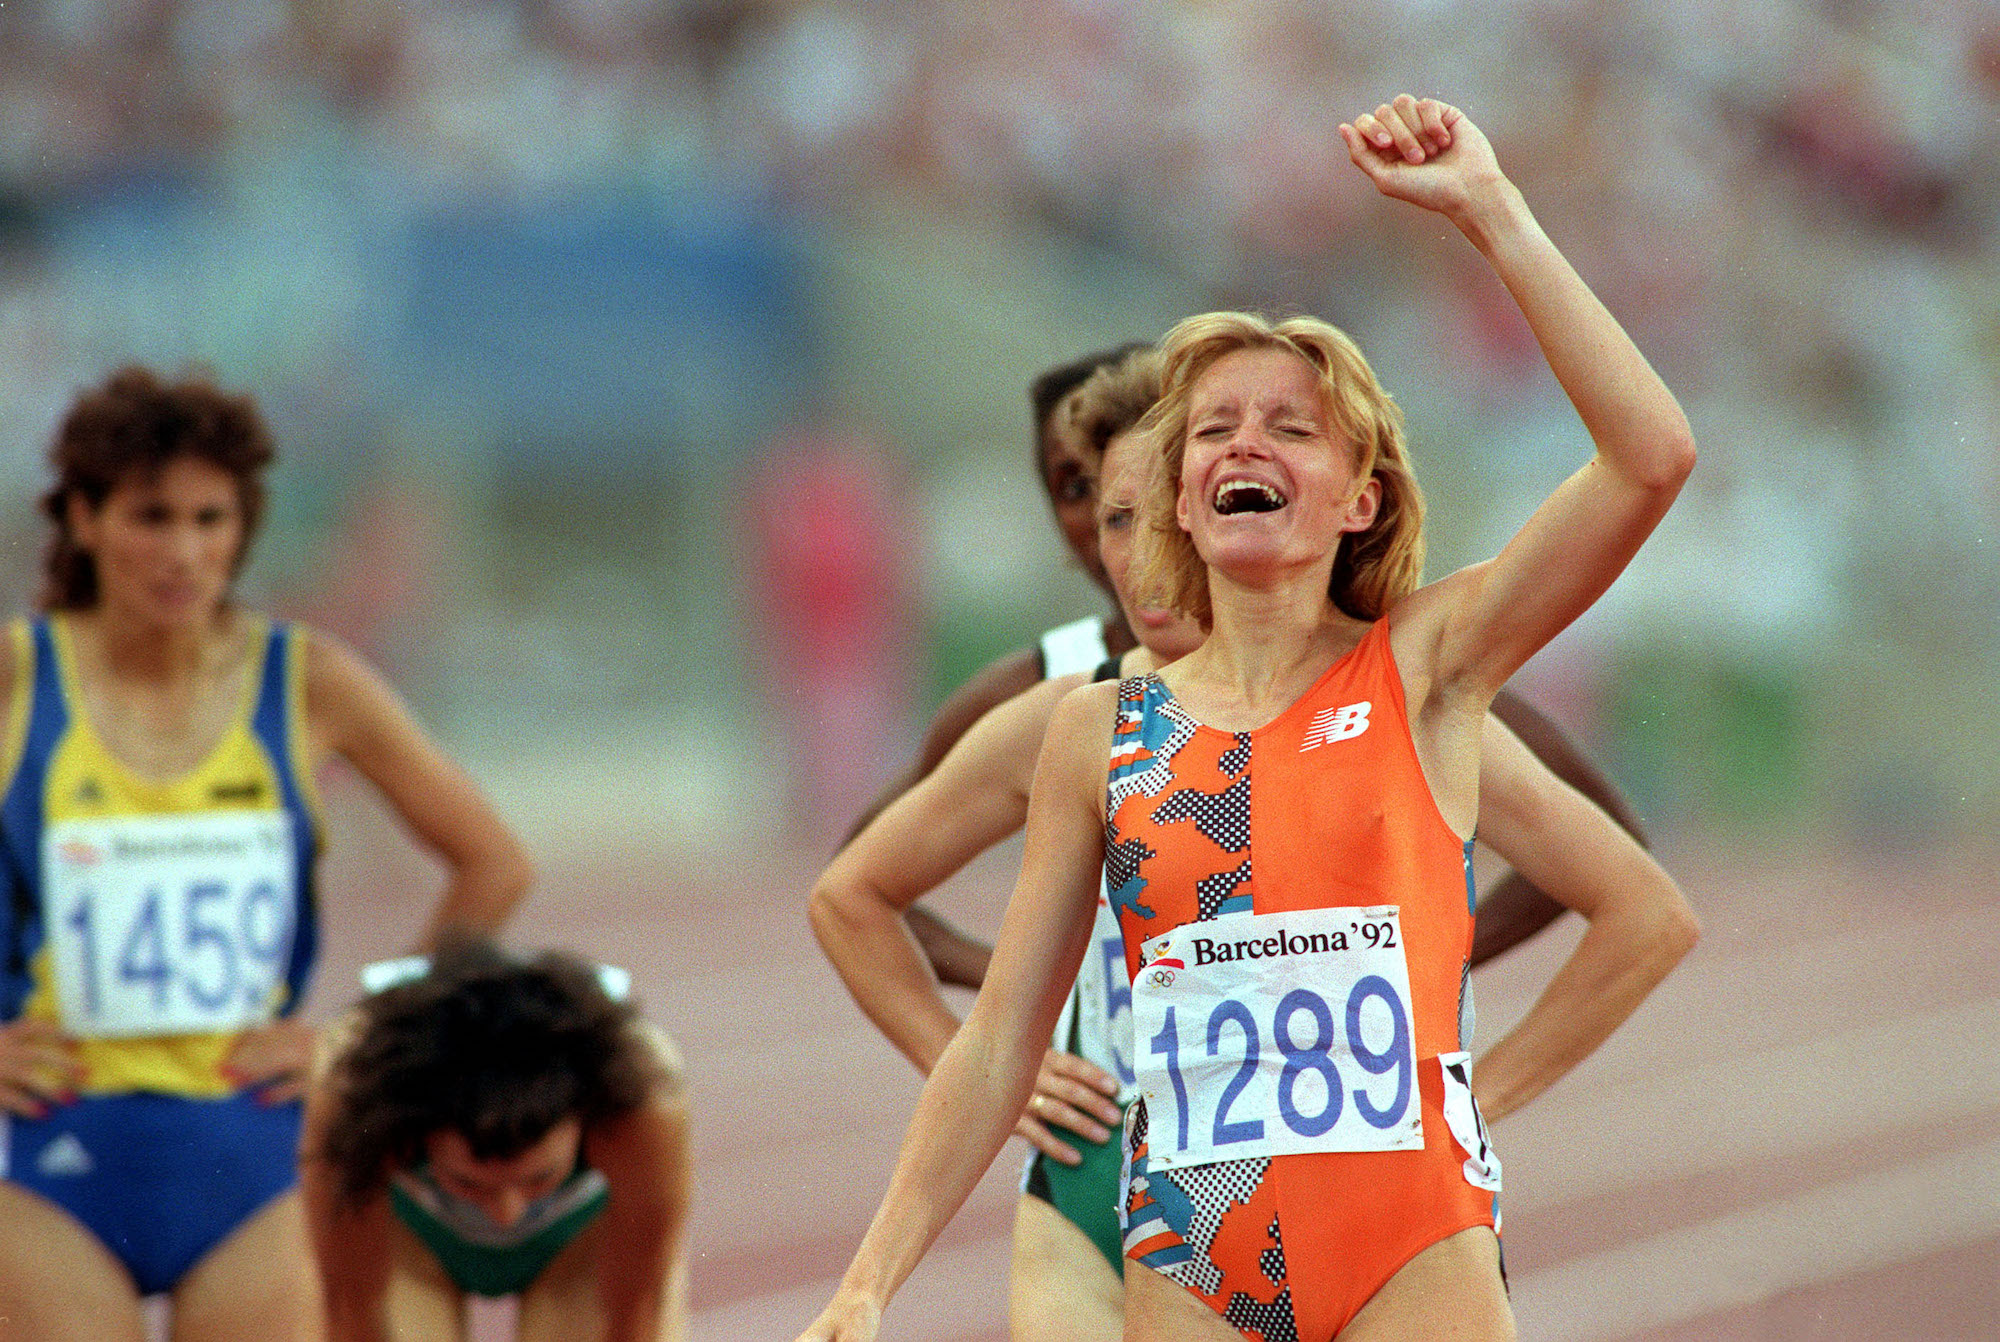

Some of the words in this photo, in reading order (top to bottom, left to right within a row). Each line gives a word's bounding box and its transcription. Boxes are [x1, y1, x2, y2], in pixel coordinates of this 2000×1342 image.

[65, 879, 293, 1016] 1459
[1191, 929, 1350, 966] Barcelona
[1150, 975, 1412, 1152] 1289
